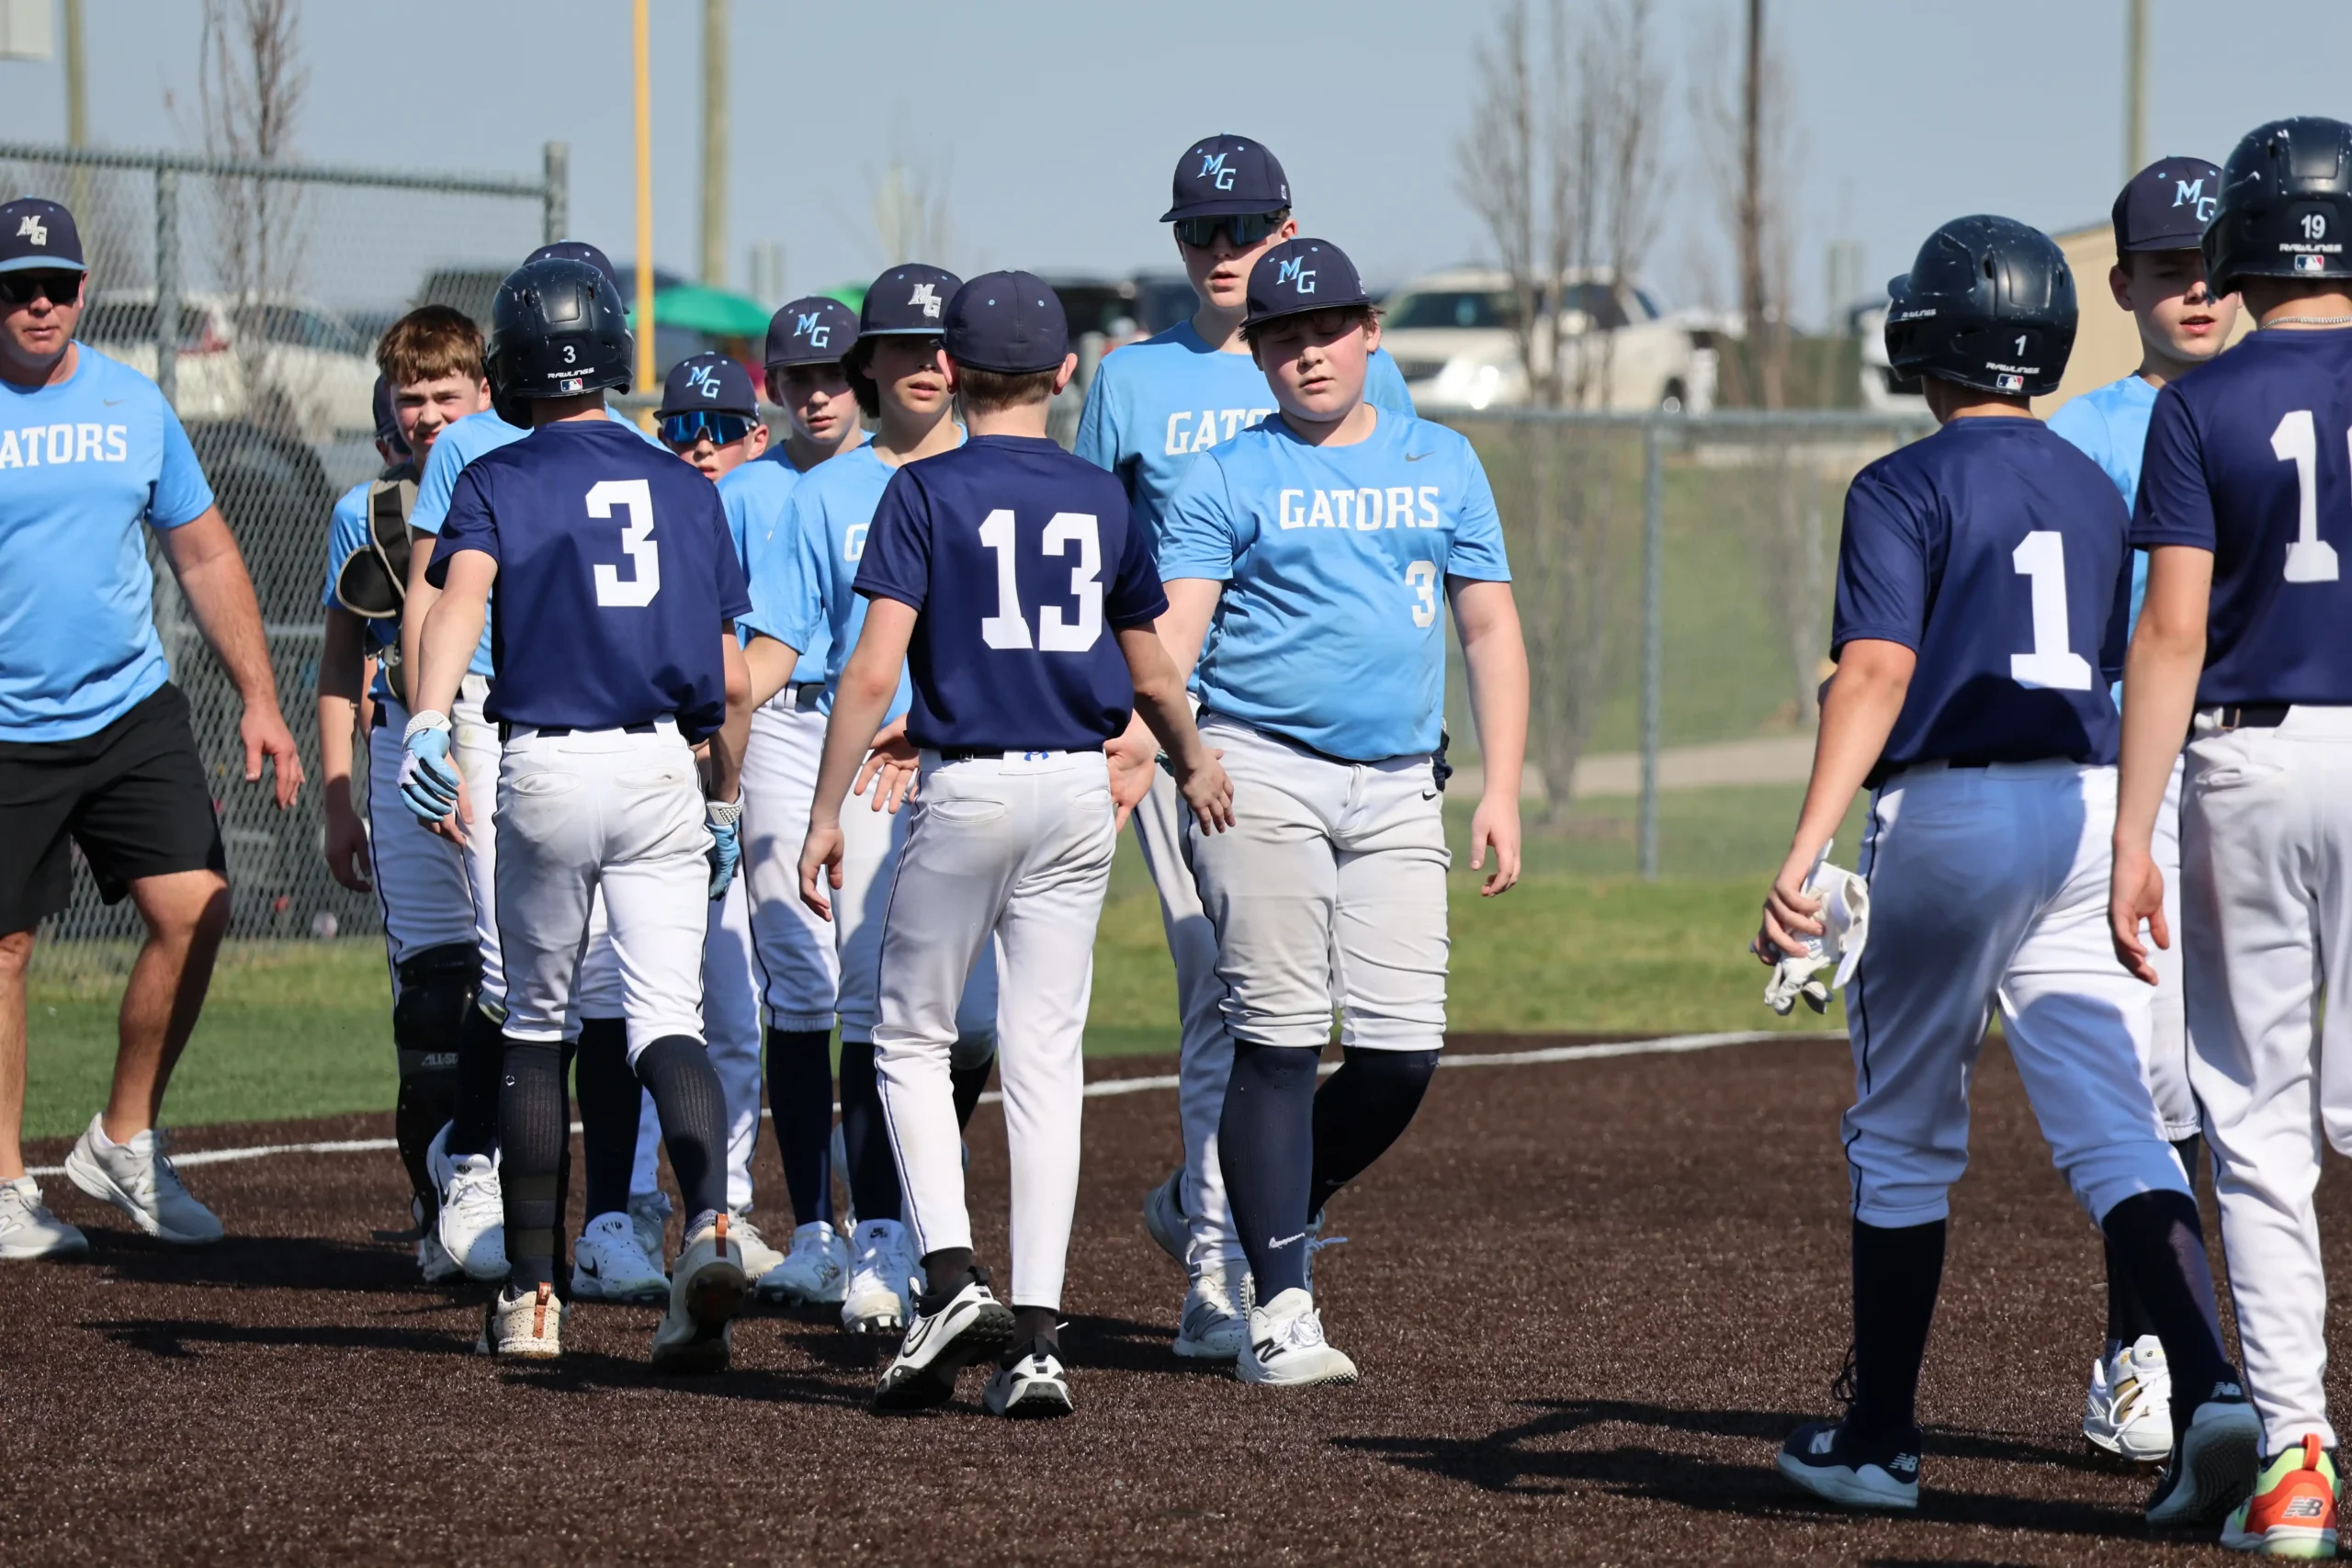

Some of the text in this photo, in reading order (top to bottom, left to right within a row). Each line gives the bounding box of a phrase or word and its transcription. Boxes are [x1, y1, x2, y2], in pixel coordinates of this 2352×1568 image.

[2301, 214, 2326, 240] 19
[2279, 243, 2343, 253] RAWLINGS
[562, 344, 577, 364] 3
[2015, 334, 2028, 356] 1
[547, 367, 595, 378] RAWLINGS
[1985, 362, 2041, 375] RAWLINGS
[0, 423, 127, 469] ATORS
[1279, 486, 1440, 531] GATORS
[585, 479, 661, 607] 3
[978, 509, 1103, 652] 13
[1405, 560, 1437, 628] 3
[2010, 530, 2092, 691] 1
[2281, 1495, 2324, 1518] NB
